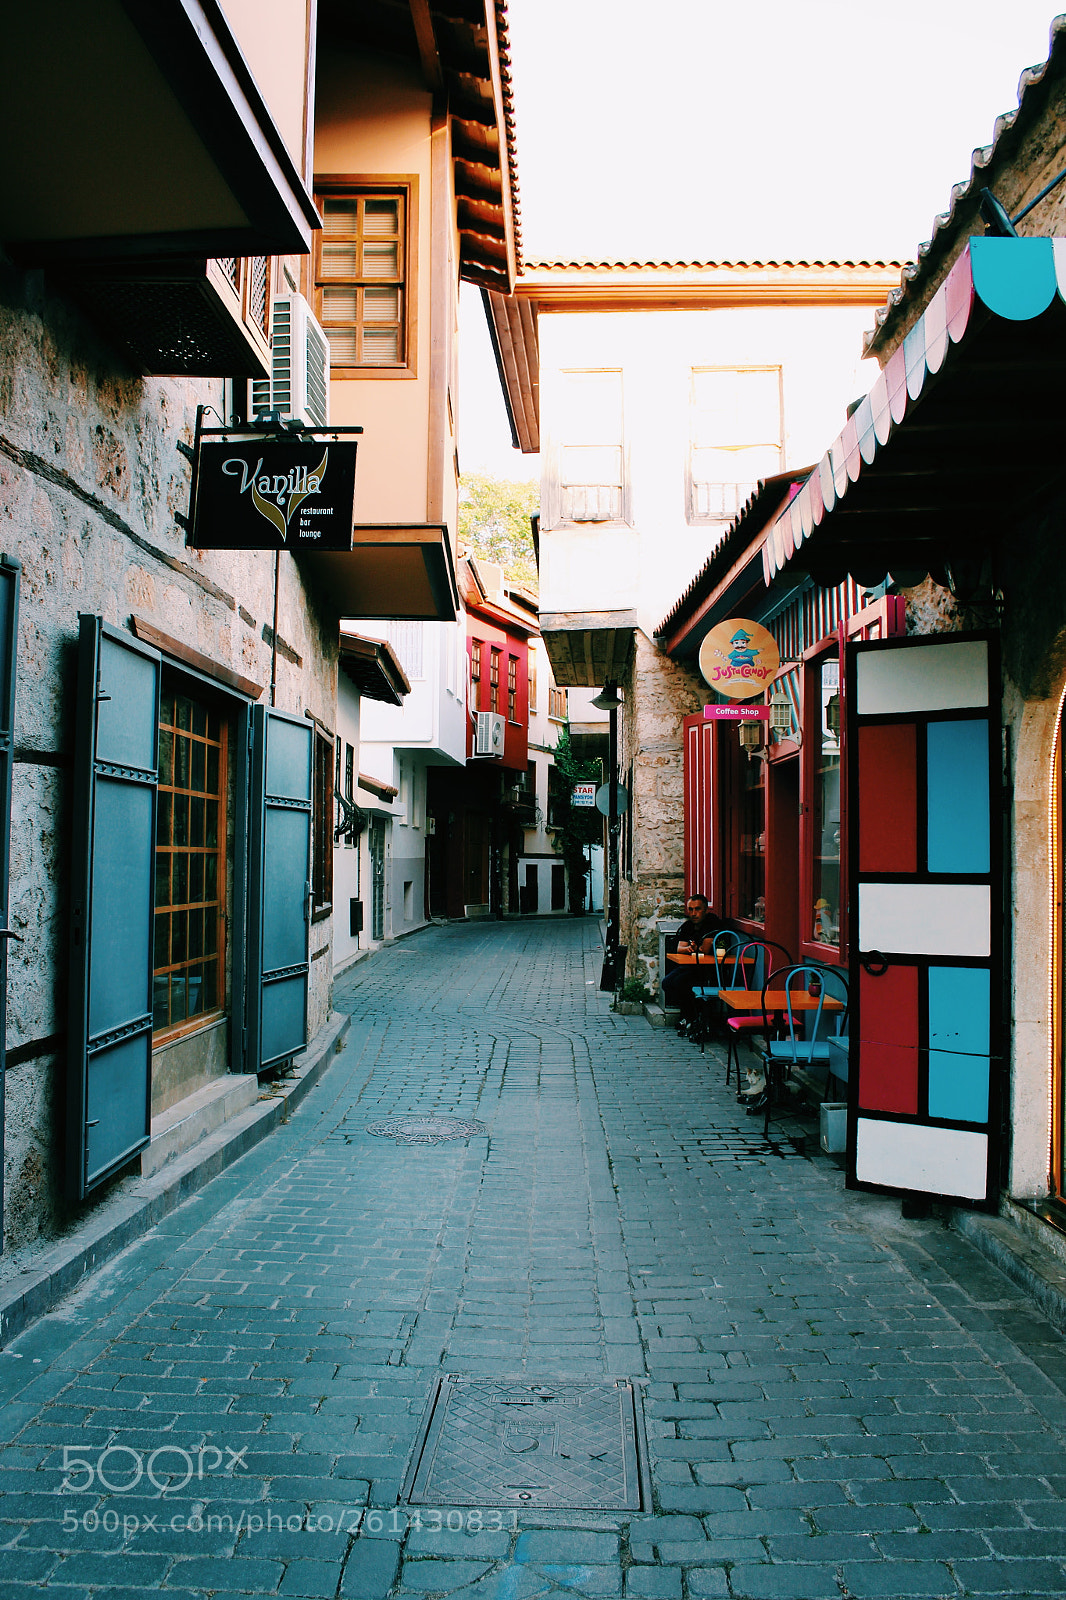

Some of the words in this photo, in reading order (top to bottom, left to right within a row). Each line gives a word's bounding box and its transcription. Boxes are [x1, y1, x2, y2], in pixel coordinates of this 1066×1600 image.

[221, 457, 322, 506] Vanilla
[300, 507, 334, 515] restaurant
[300, 518, 311, 526] bar
[299, 529, 322, 540] lounge
[715, 707, 739, 715] Coffee
[740, 707, 759, 717] Shop
[573, 786, 593, 794] STAR
